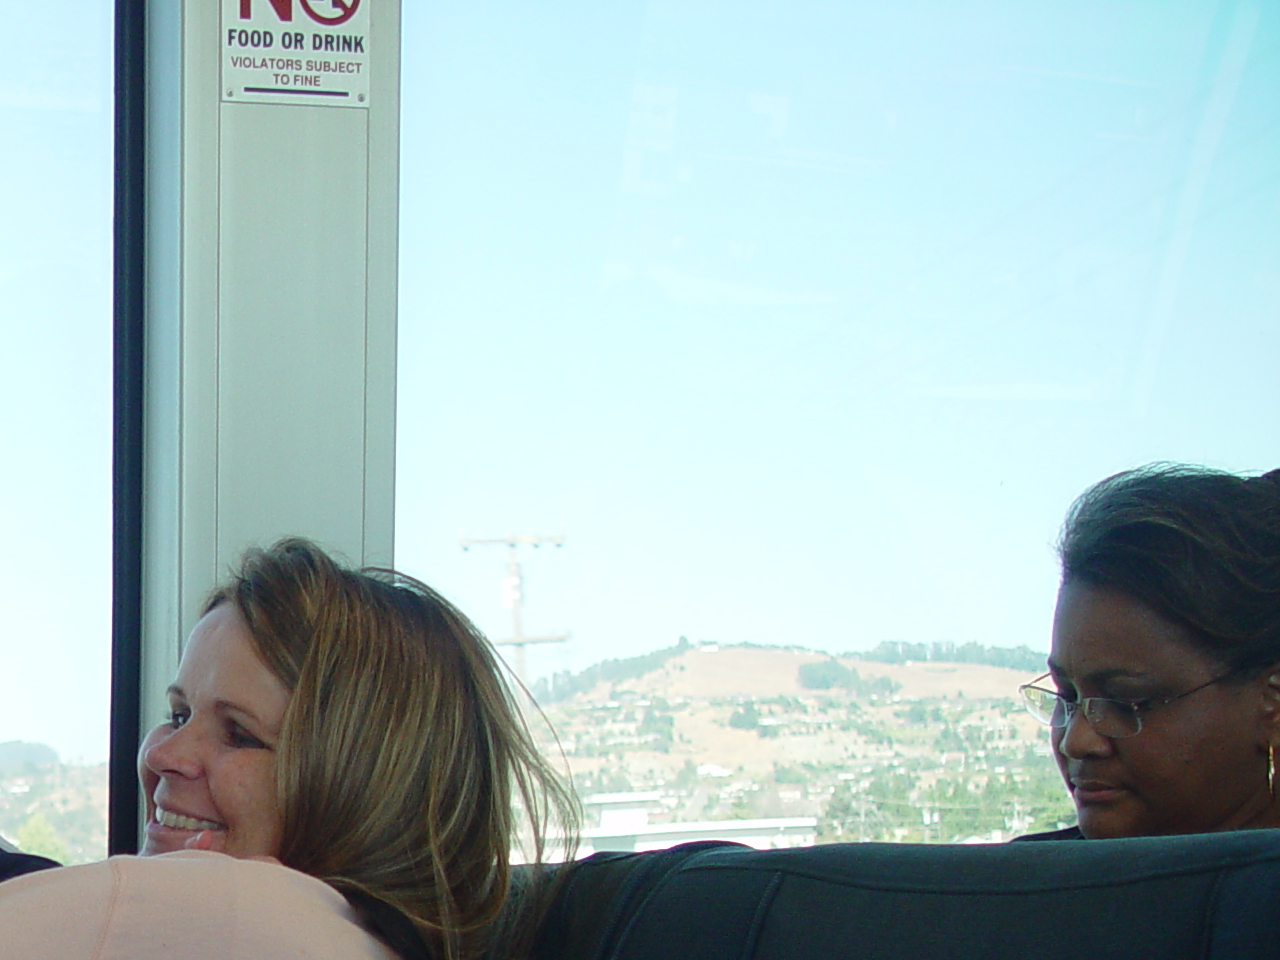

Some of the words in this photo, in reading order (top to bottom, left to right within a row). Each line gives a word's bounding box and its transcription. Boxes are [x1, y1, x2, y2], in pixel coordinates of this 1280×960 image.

[227, 29, 273, 48] FOOD
[281, 31, 305, 50] OR
[312, 33, 365, 53] DRINK
[231, 56, 302, 71] VIOLATORS
[305, 60, 362, 74] SUBJECT
[273, 73, 290, 85] TO
[293, 75, 321, 87] FINE
